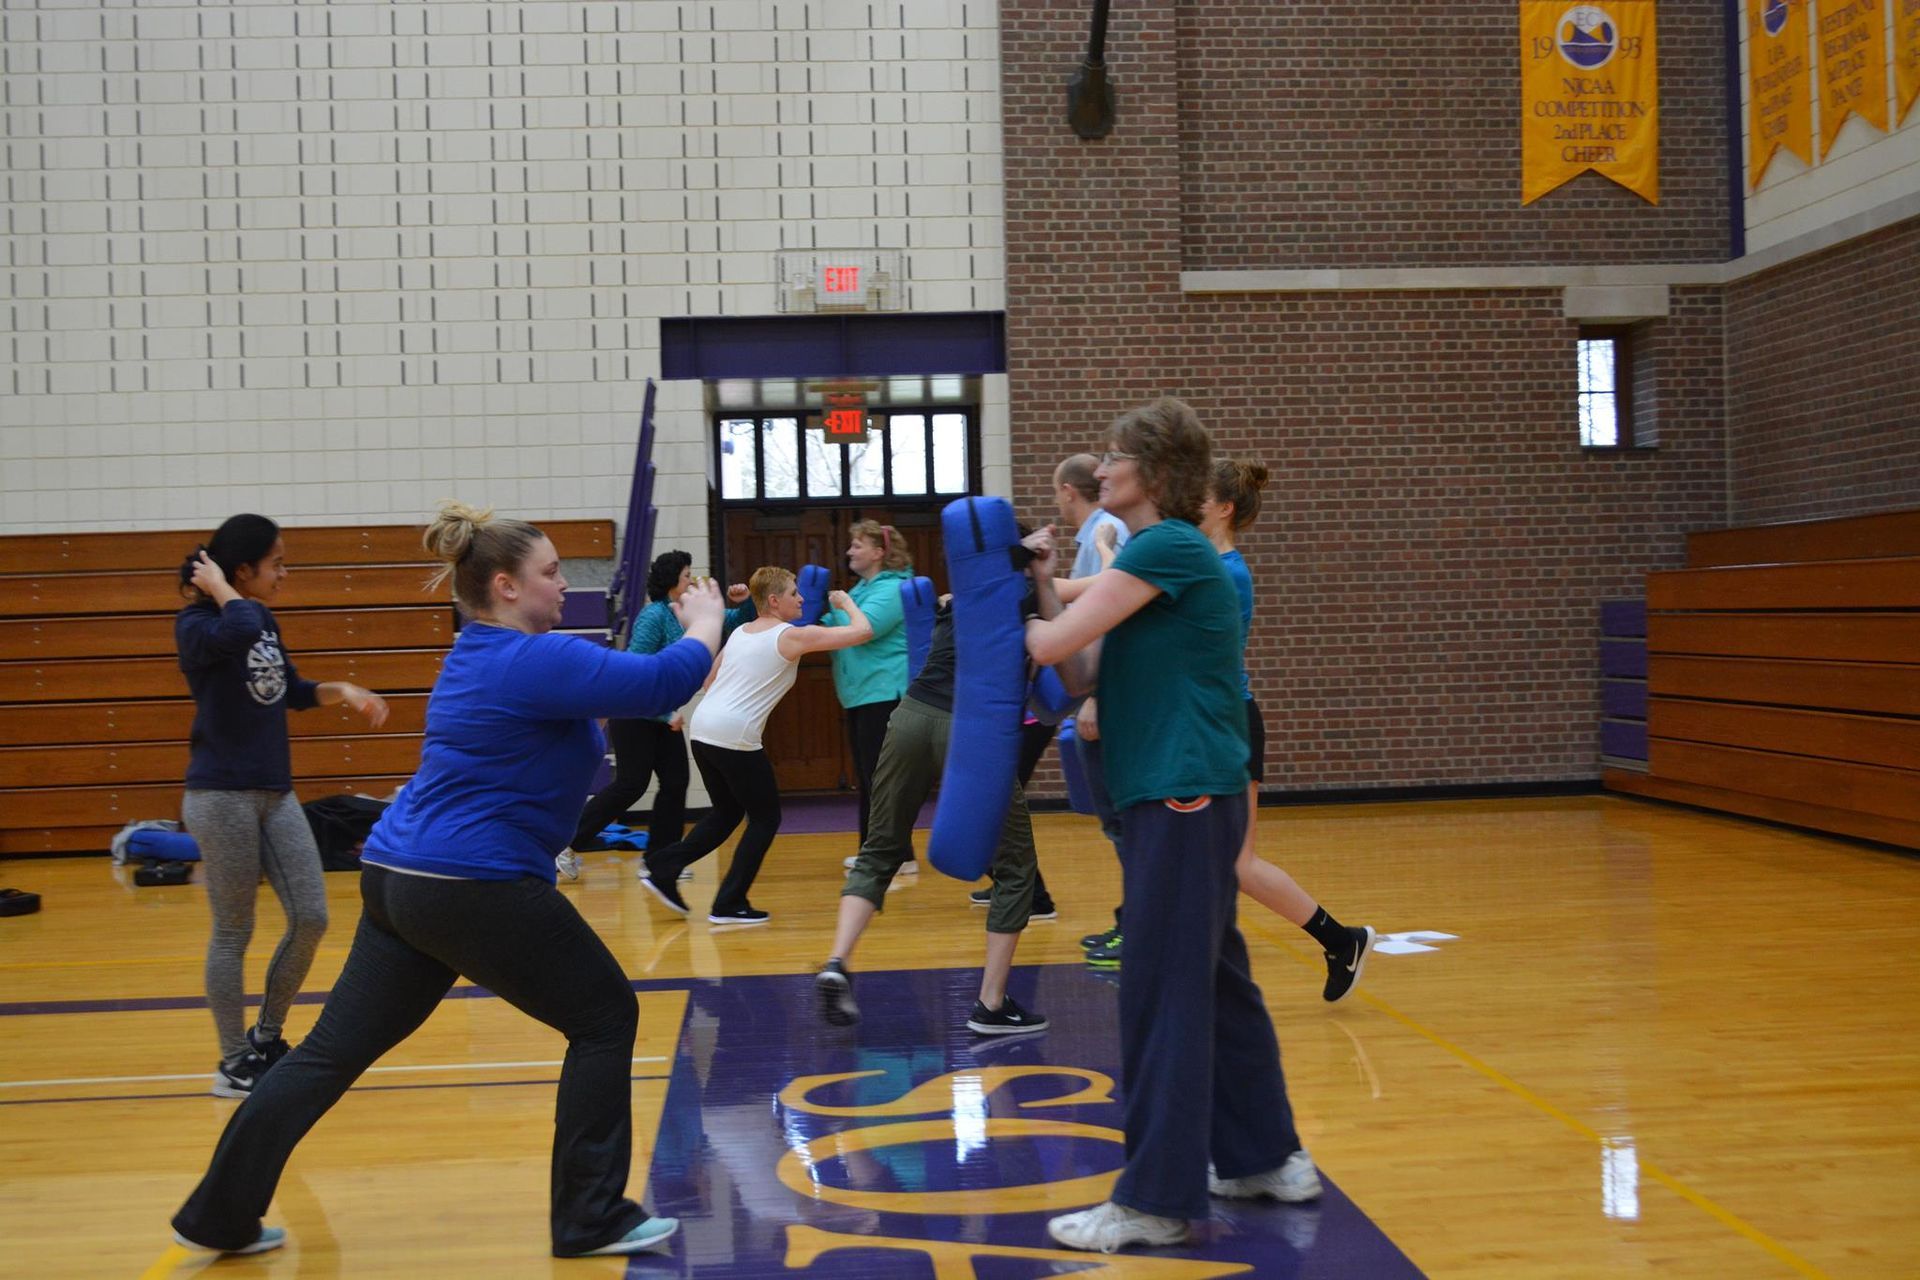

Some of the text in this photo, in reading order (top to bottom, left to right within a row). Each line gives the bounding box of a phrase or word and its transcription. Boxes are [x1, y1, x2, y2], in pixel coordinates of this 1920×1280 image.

[1575, 11, 1601, 26] EC
[1532, 36, 1642, 59] 19 93
[1535, 101, 1646, 118] COMPETITION
[1562, 146, 1616, 163] CHEER
[825, 266, 860, 292] EXIT
[831, 410, 862, 434] EXIT
